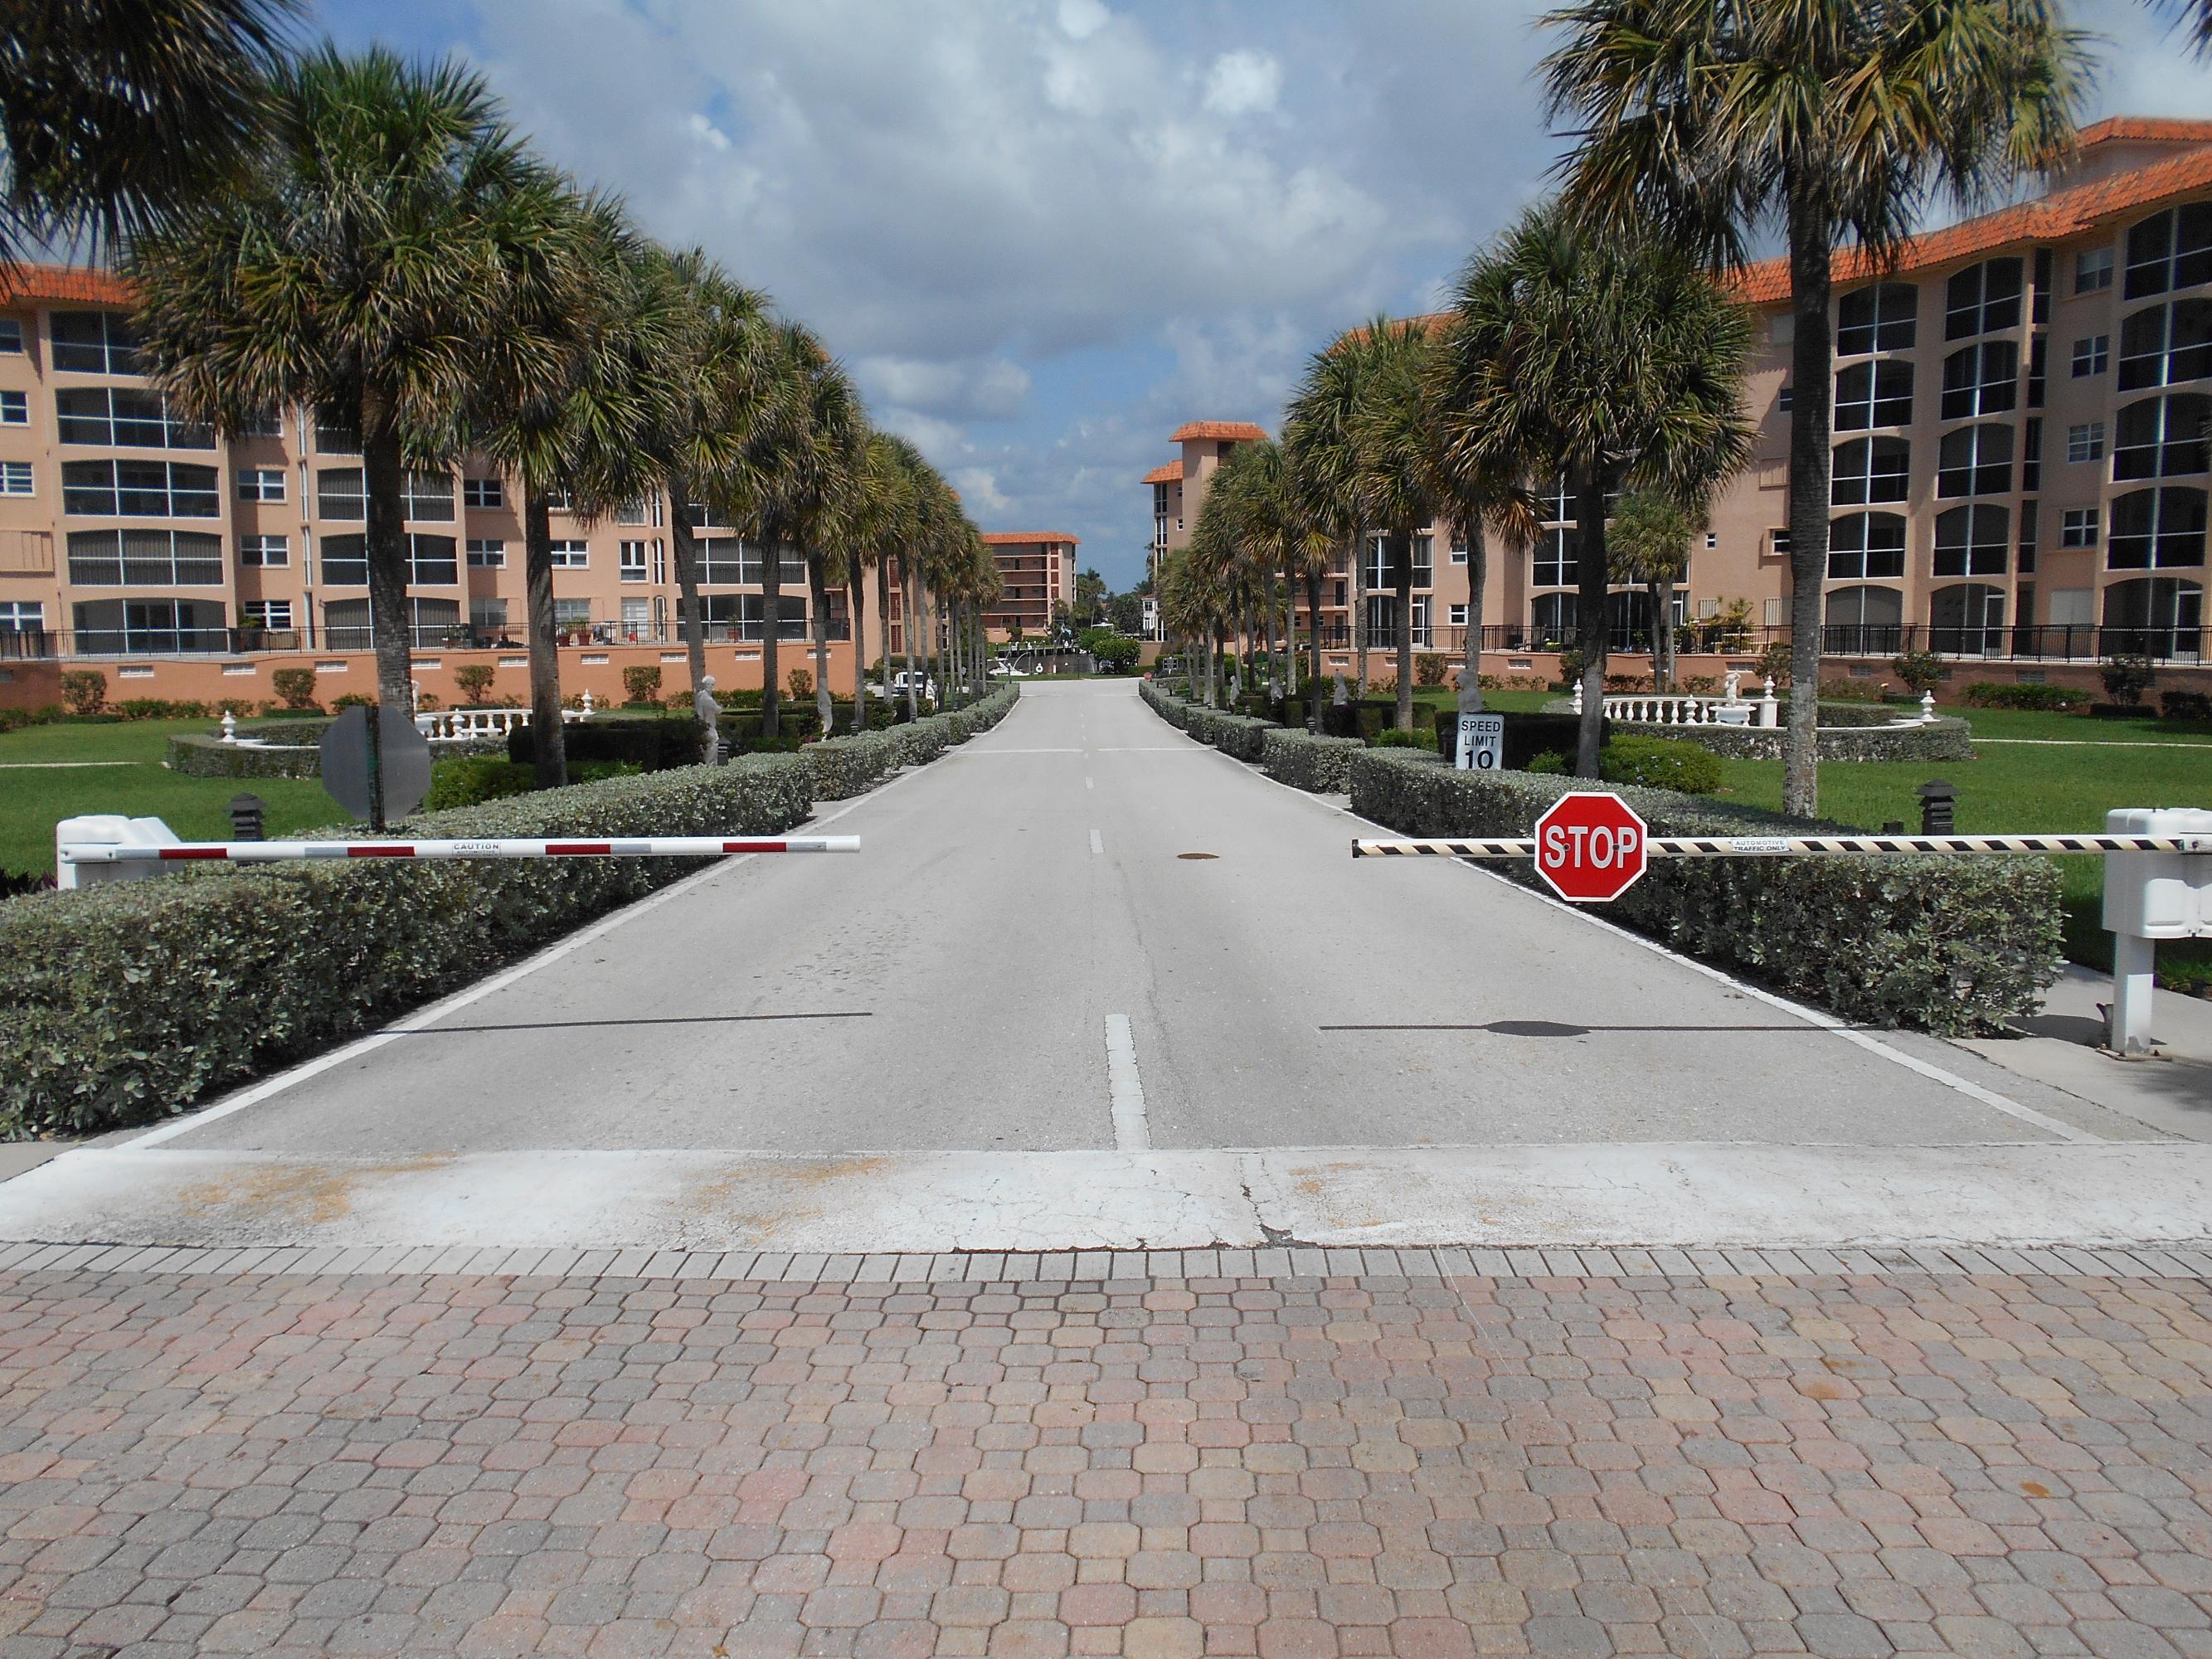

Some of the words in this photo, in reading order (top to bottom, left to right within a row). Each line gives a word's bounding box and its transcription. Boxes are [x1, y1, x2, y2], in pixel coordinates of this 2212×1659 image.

[1461, 720, 1500, 732] SPEED
[1464, 736, 1496, 747] LIMIT
[1465, 750, 1494, 769] 10
[1544, 825, 1637, 868] STOP
